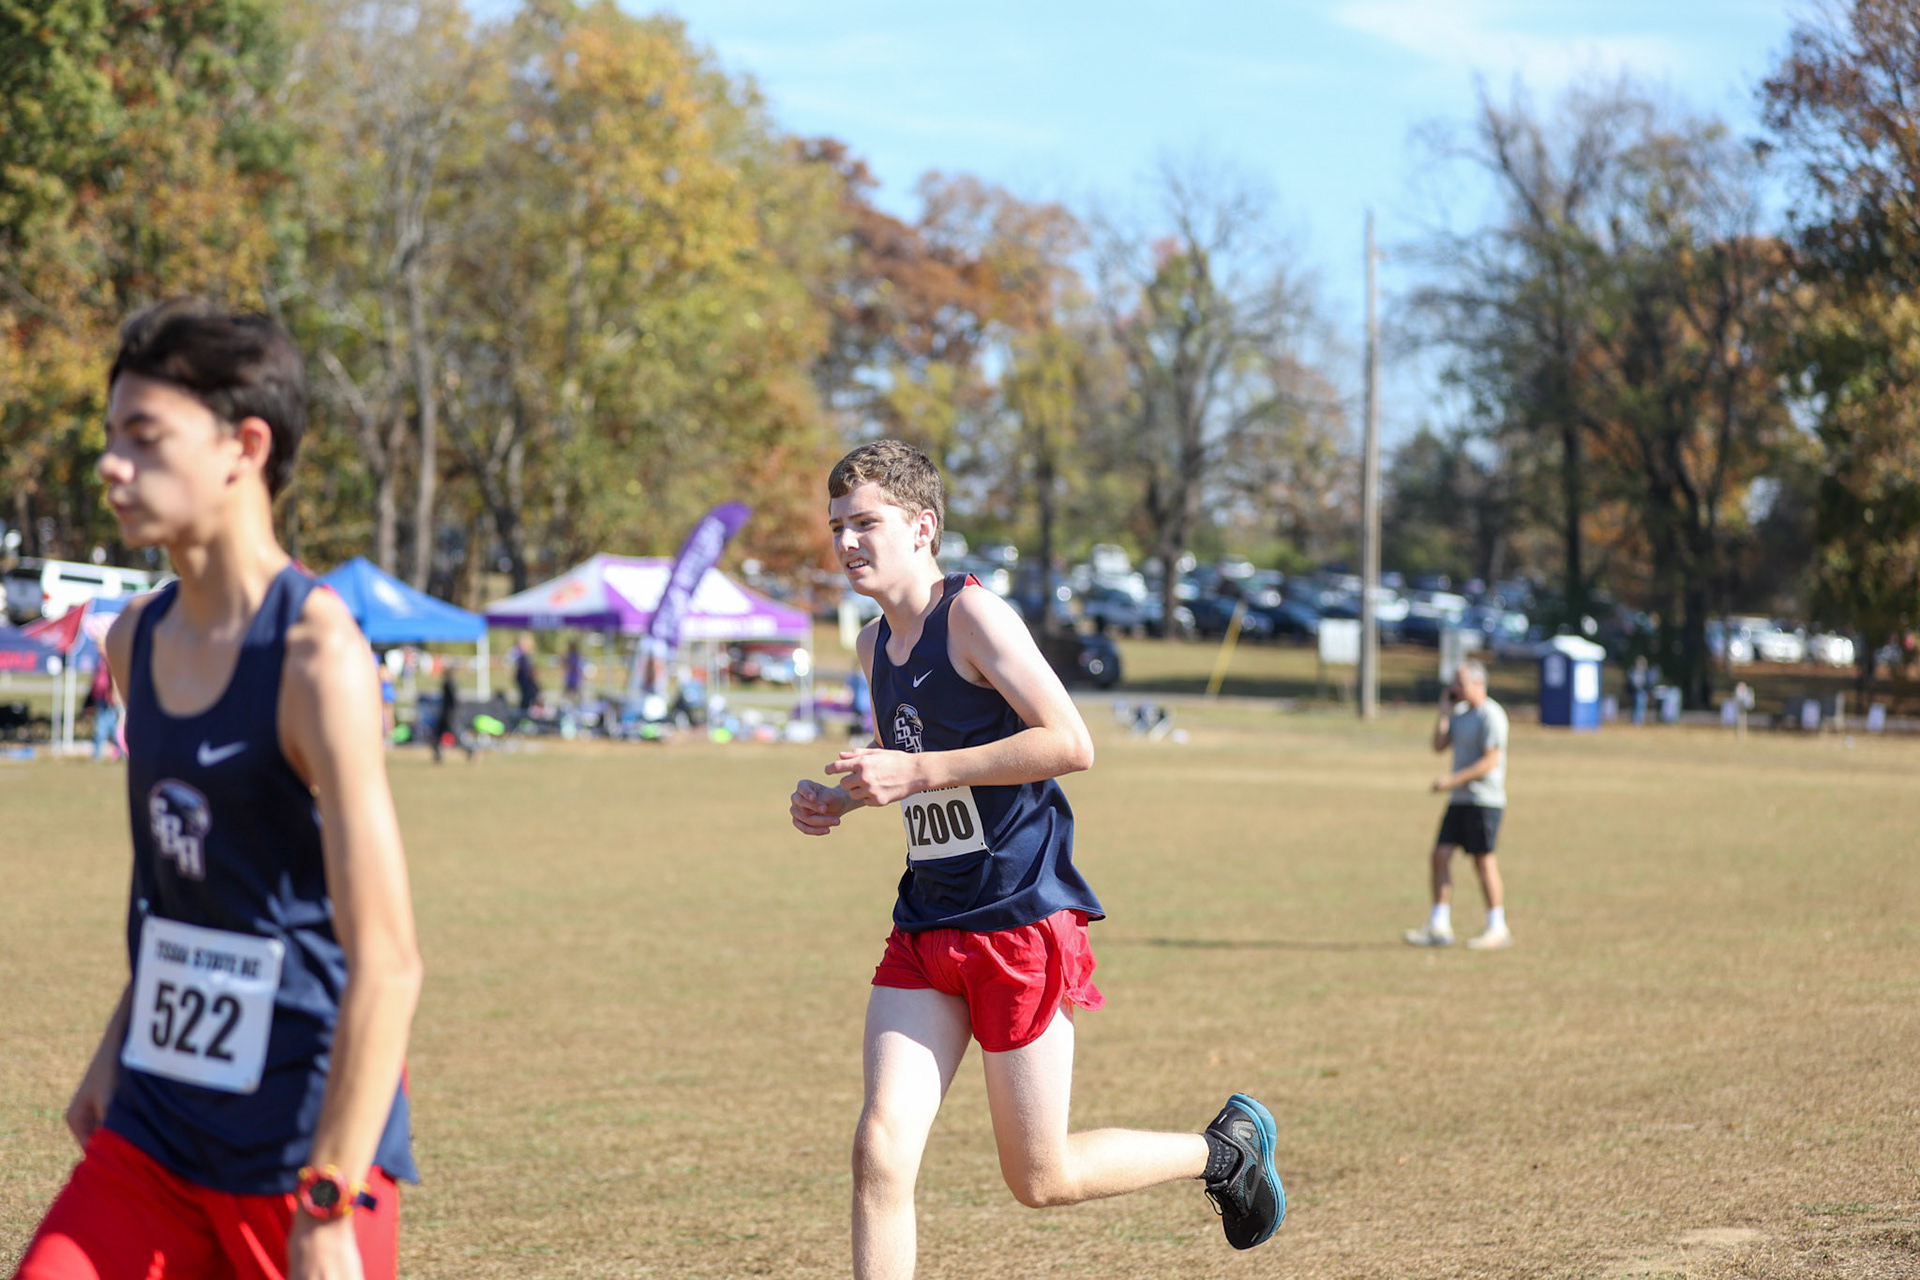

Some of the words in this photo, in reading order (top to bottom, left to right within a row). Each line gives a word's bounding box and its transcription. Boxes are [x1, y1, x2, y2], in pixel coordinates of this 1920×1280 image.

[905, 799, 974, 846] 1200
[193, 949, 237, 972] STATE
[151, 980, 242, 1062] 522
